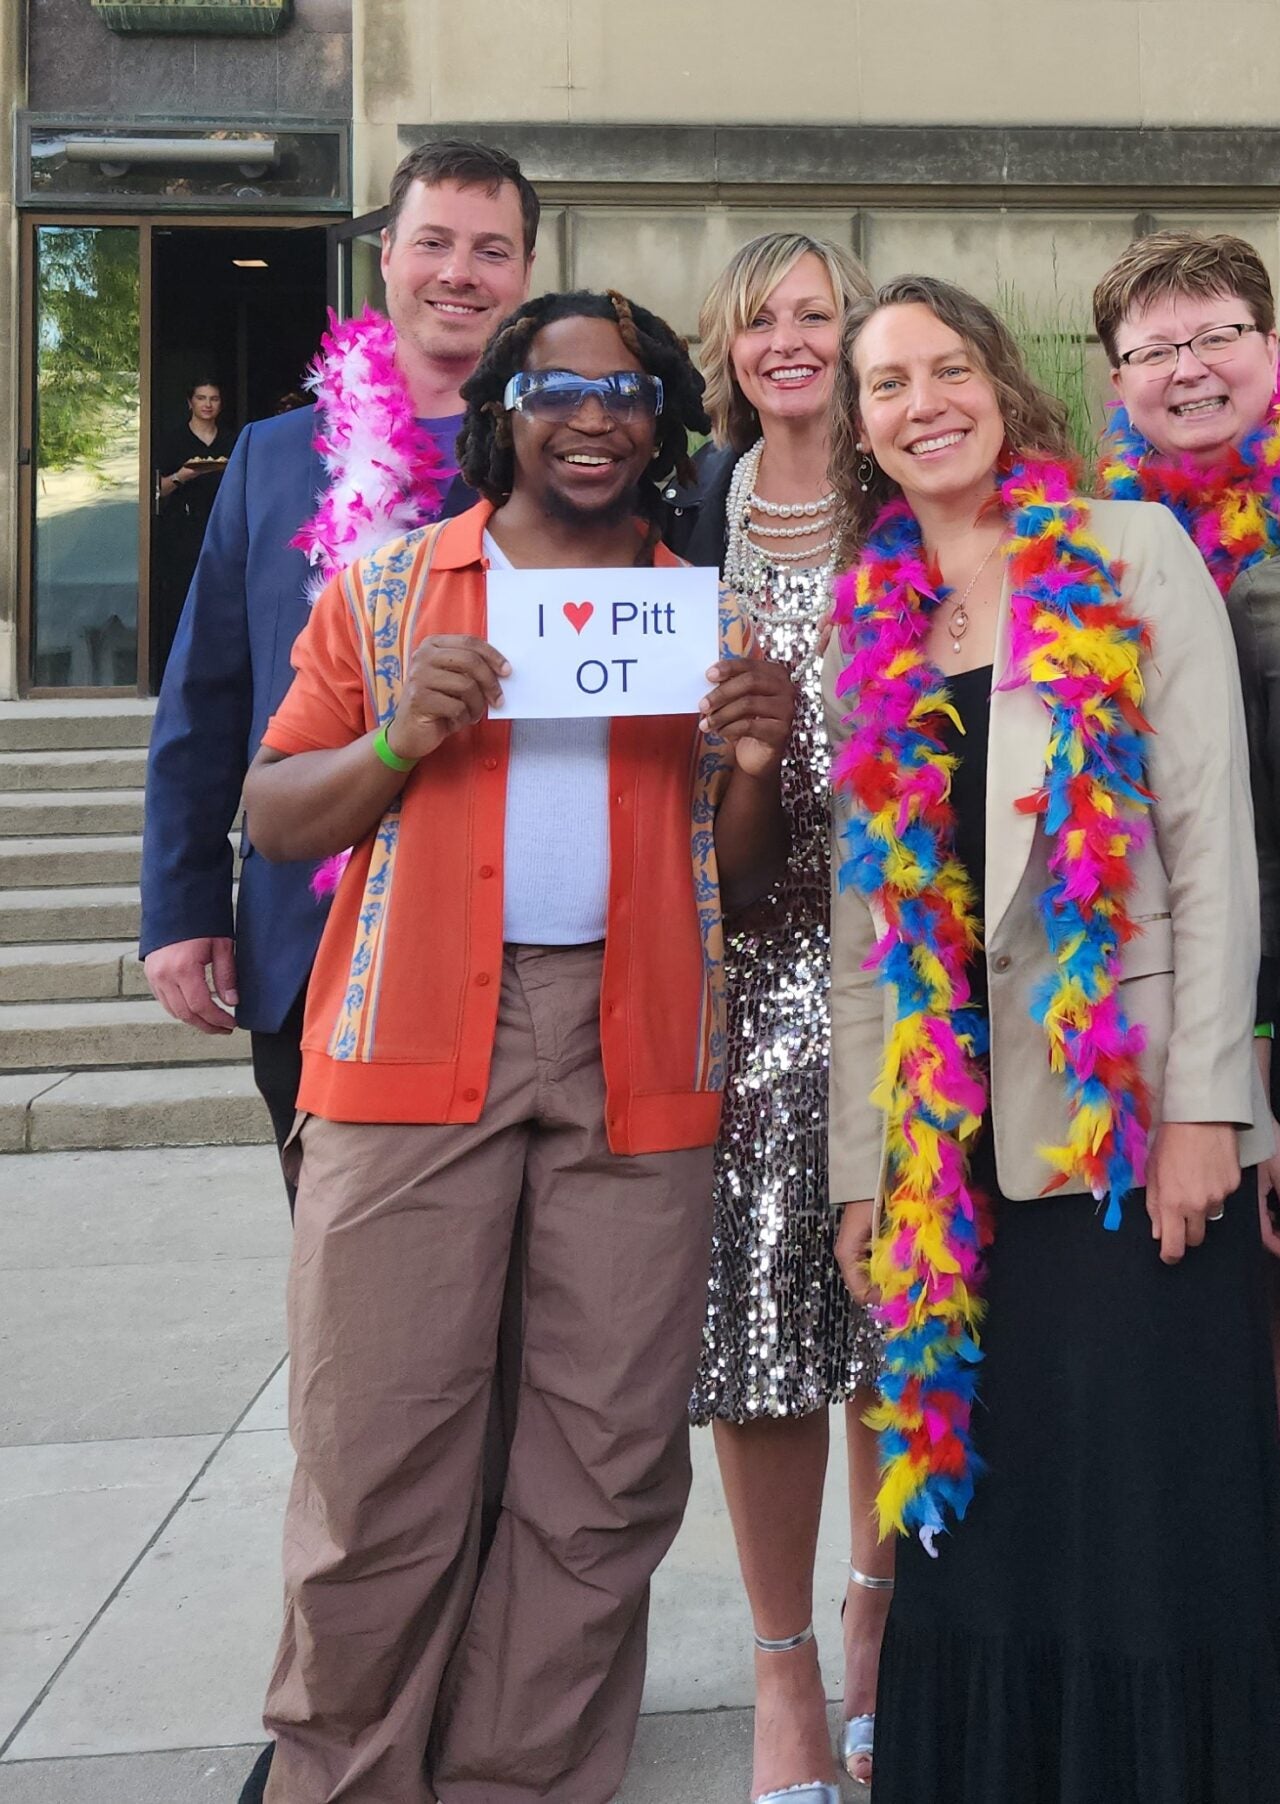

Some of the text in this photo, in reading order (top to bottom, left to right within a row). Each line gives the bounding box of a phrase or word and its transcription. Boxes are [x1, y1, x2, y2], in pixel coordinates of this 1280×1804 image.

[538, 601, 676, 637] I Pitt
[576, 659, 638, 694] OT
